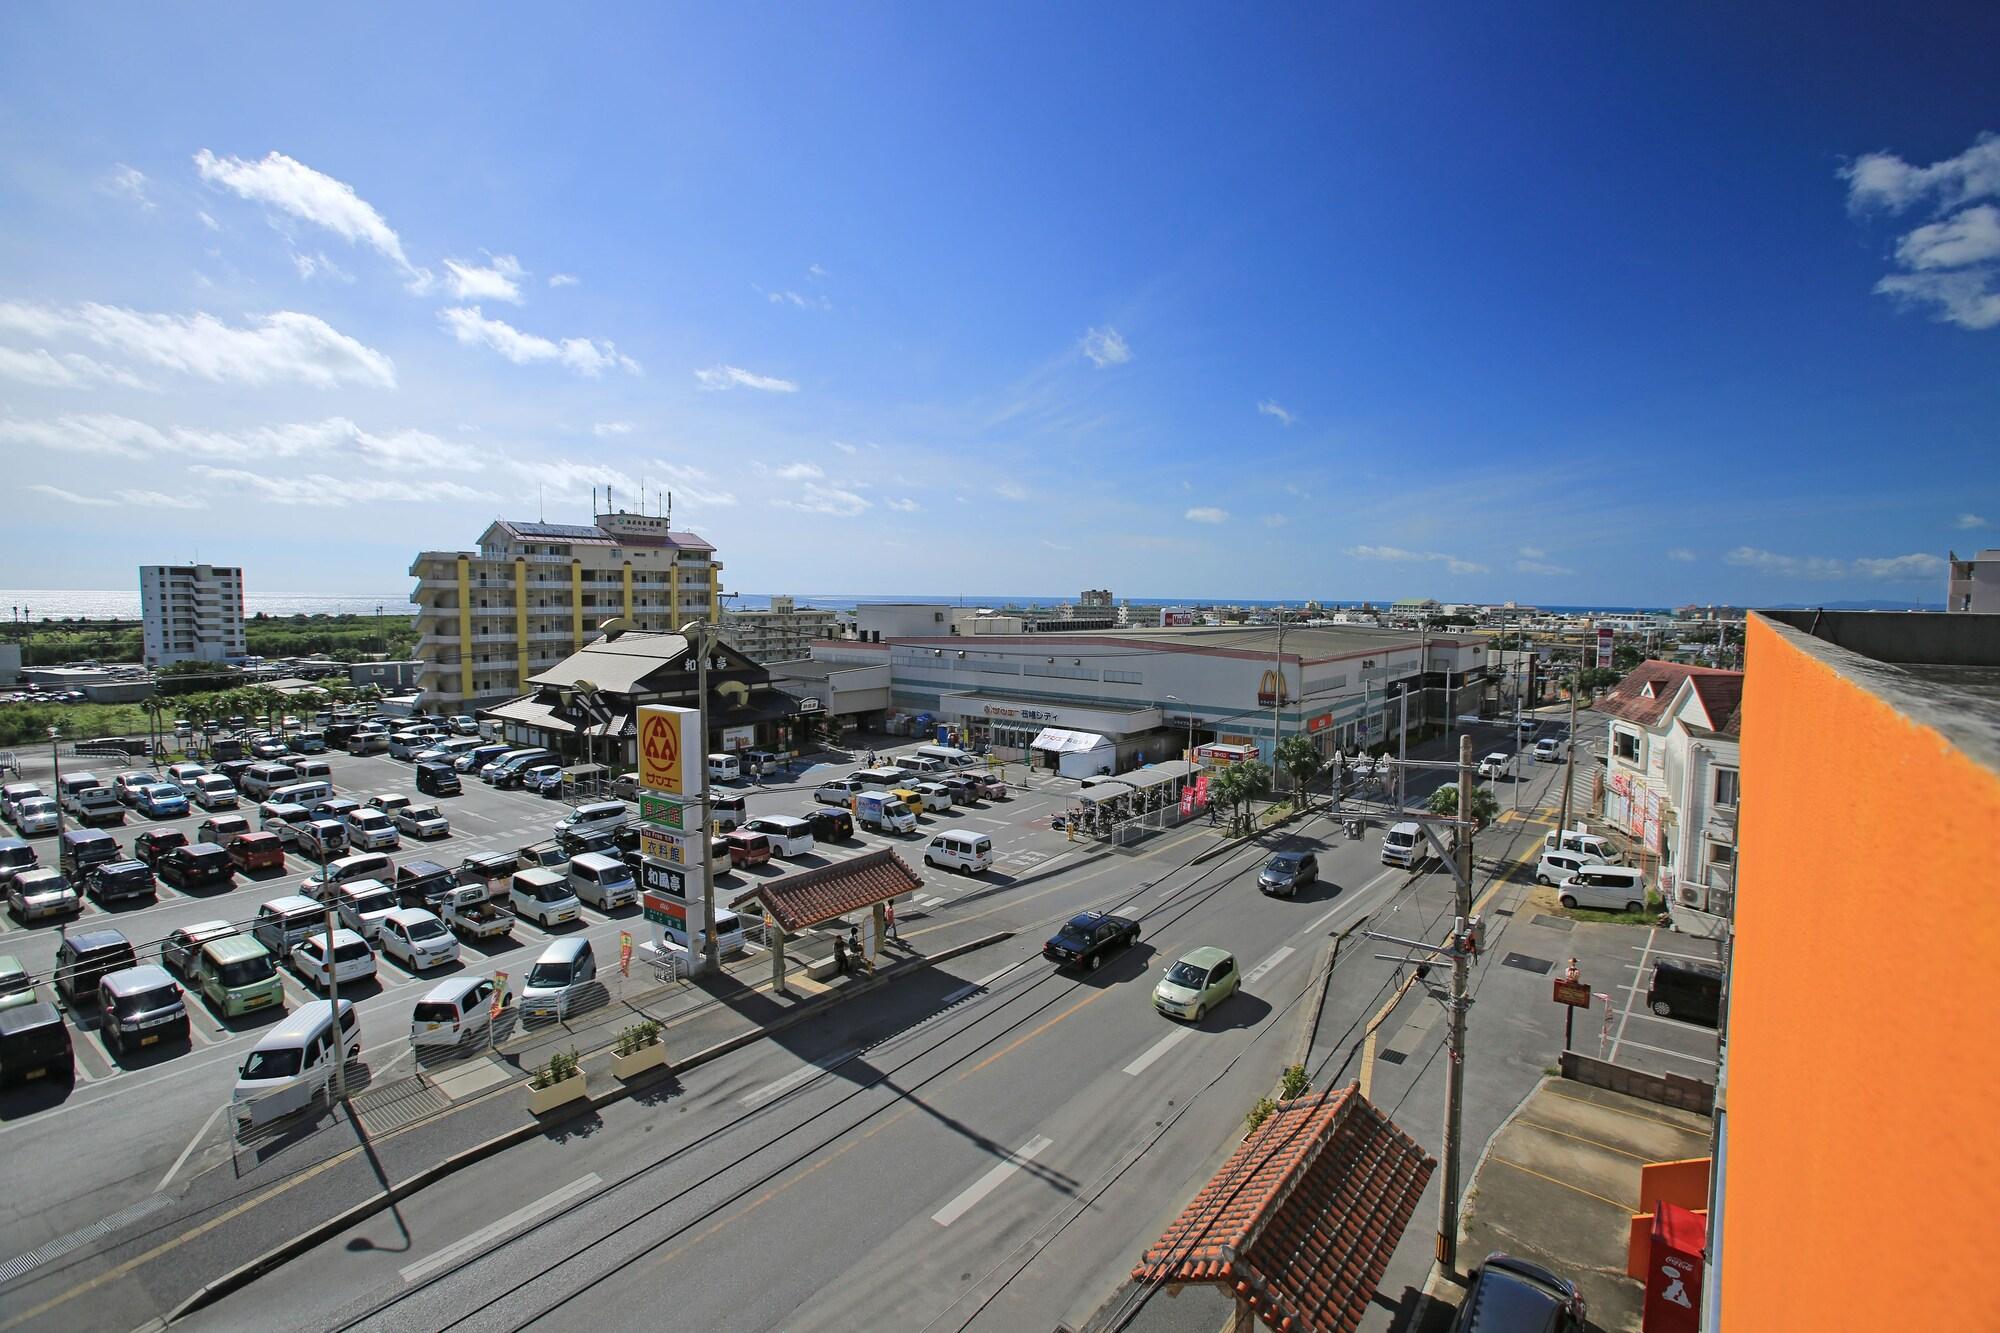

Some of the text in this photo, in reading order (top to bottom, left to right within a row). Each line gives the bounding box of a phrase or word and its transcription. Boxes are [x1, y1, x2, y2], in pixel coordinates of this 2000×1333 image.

[646, 771, 679, 788] サンエー
[644, 800, 681, 825] 食品館
[647, 840, 680, 862] 衣料館
[647, 867, 681, 892] 和風亭
